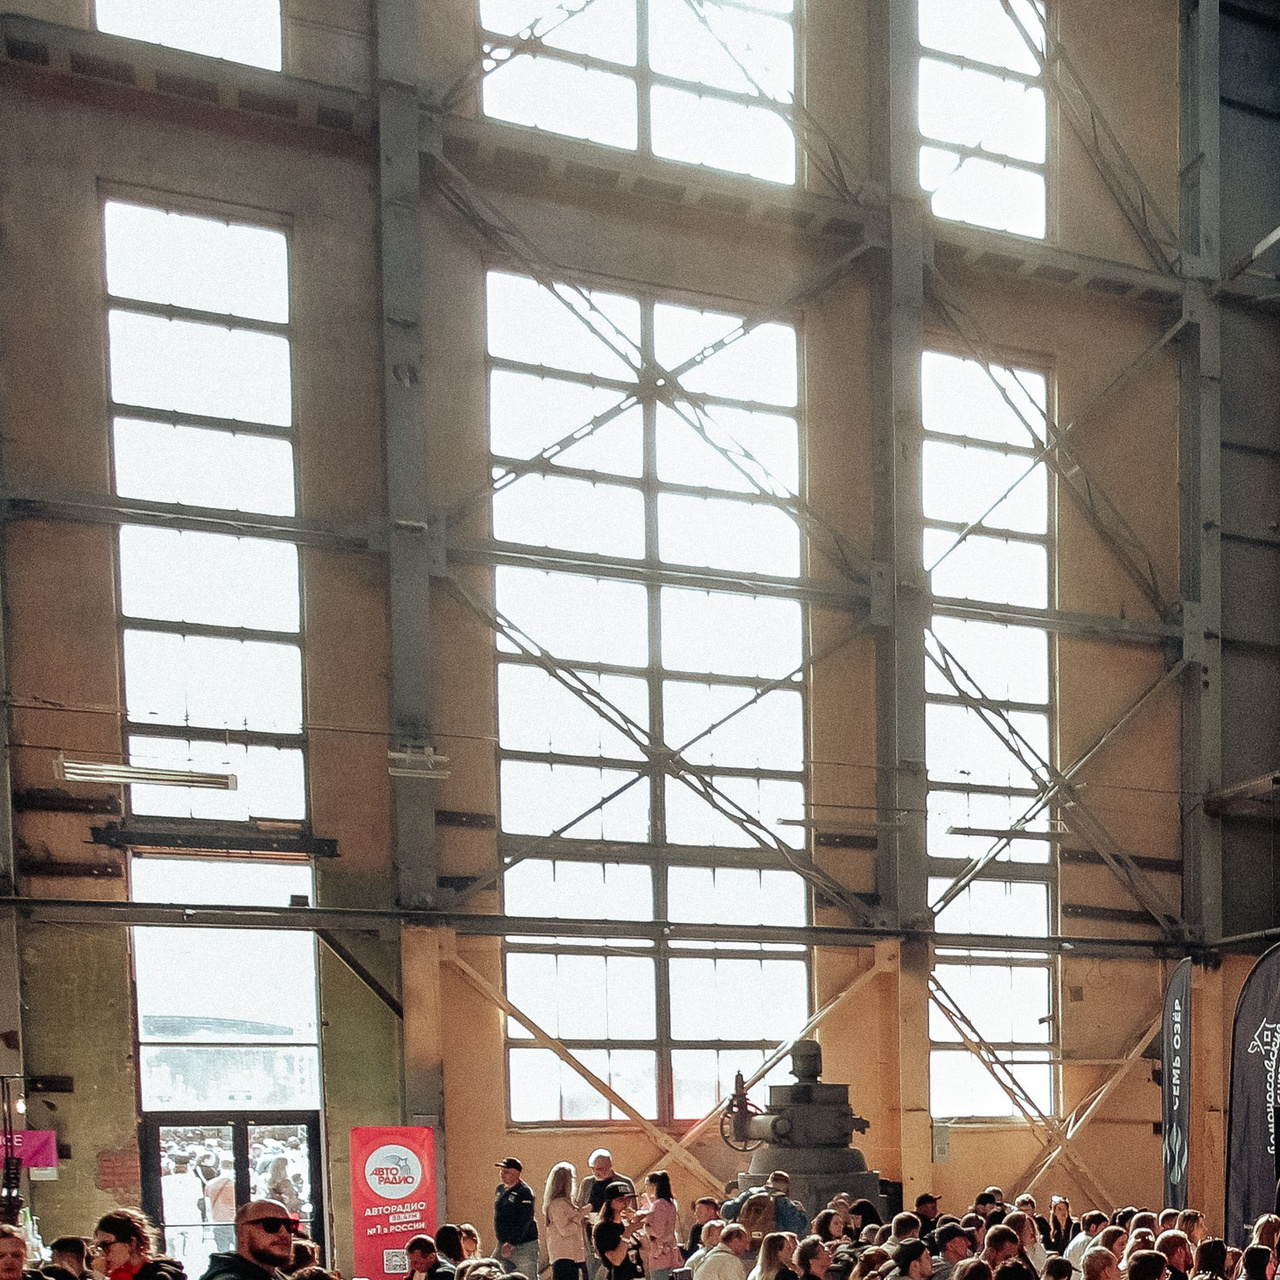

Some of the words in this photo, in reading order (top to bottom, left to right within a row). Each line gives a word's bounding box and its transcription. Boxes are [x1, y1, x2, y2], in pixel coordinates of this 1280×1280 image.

[1172, 998, 1182, 1050] ОЗЁР
[369, 1167, 399, 1176] АВТО
[378, 1175, 415, 1185] РАДИО
[364, 1202, 426, 1216] АВТОРАДИО
[390, 1222, 426, 1232] РОССИИ
